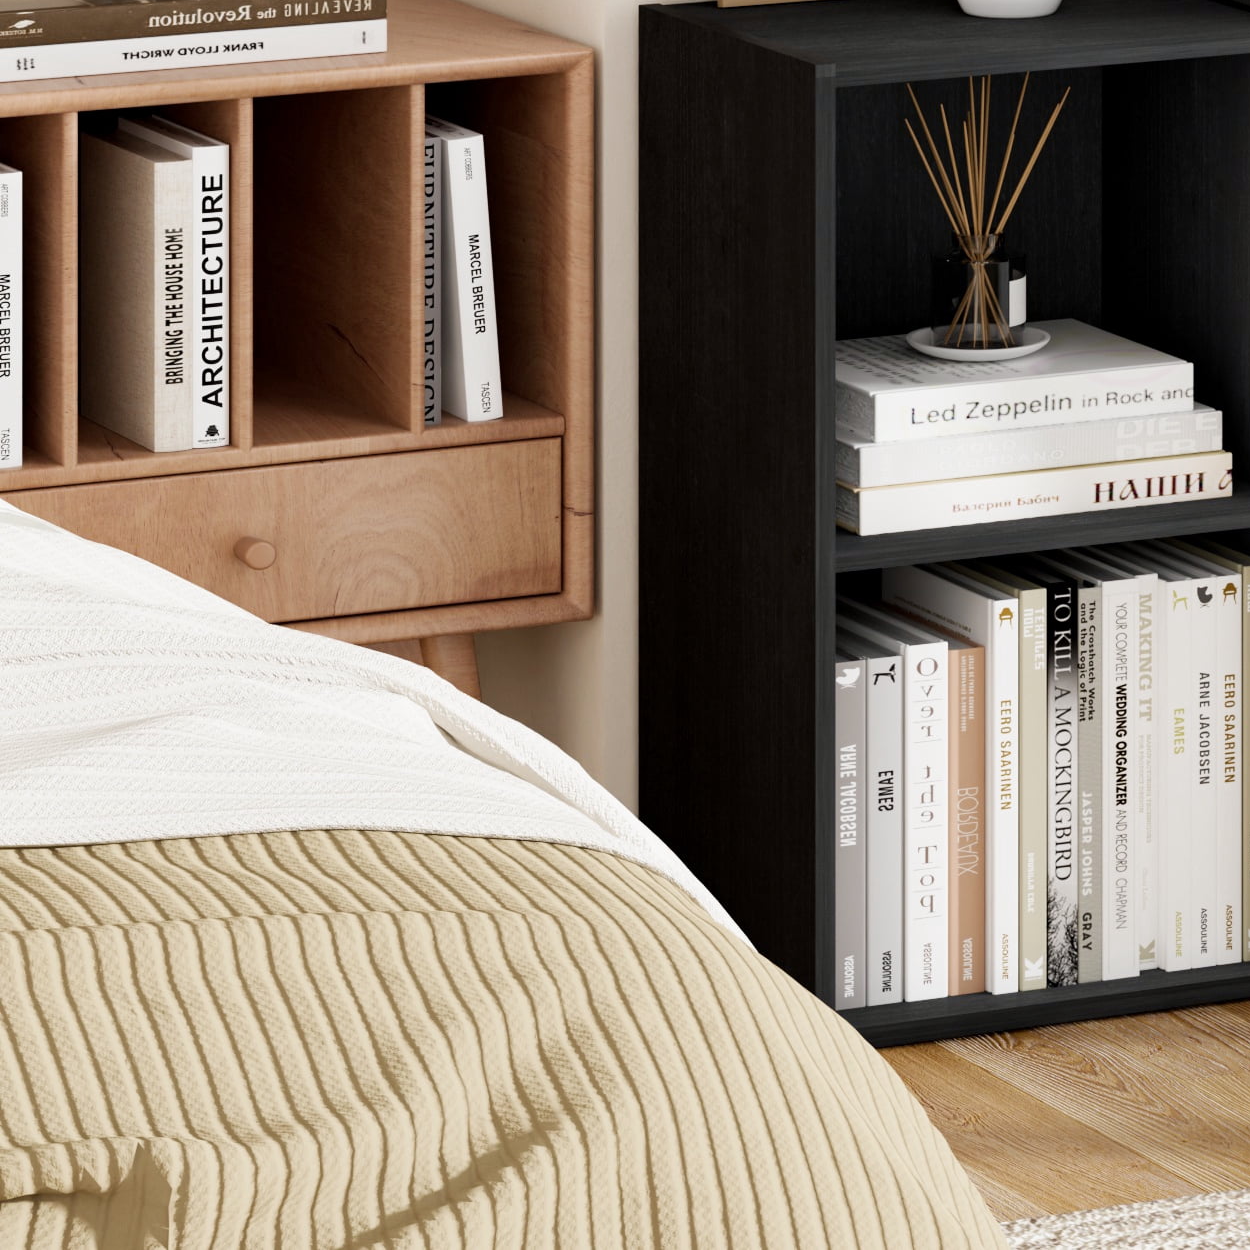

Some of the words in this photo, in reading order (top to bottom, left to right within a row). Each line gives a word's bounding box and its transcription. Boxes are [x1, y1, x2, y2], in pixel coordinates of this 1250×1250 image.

[165, 227, 183, 260] HOME
[468, 234, 483, 283] MARCEL
[0, 274, 11, 325] MARCEL
[165, 263, 183, 301] HOUSE
[201, 174, 223, 407] ARCHITECTURE
[165, 304, 183, 327] THE
[473, 286, 486, 335] BREUER
[0, 328, 11, 378] BREUER
[165, 329, 183, 385] BRINGING
[911, 403, 956, 426] Led
[966, 393, 1072, 422] Zeppelin
[1082, 394, 1099, 409] in
[1106, 390, 1153, 406] Rock
[1093, 471, 1205, 503] НАШИ
[1054, 587, 1072, 623] TO
[1115, 603, 1127, 630] YOUR
[1054, 629, 1072, 681] KILL
[1078, 651, 1087, 678] Logic
[1115, 633, 1127, 682] COMPLETE
[1138, 593, 1153, 690] MAKING
[1054, 686, 1072, 703] A
[1080, 682, 1087, 693] of
[1138, 697, 1153, 721] IT
[1200, 672, 1210, 707] ARNE
[1224, 674, 1236, 709] EERO
[1000, 700, 1012, 735] EERO
[1115, 685, 1127, 738] WEDDING
[1174, 708, 1185, 755] EAMES
[1200, 713, 1210, 785] JACOBSEN
[1224, 714, 1236, 783] SAARINEN
[1000, 741, 1012, 811] SAARINEN
[1054, 707, 1073, 882] MOCKINGBIRD
[1115, 742, 1127, 806] ORGANIZER
[1082, 791, 1092, 844] JASPER
[1115, 810, 1127, 831] AND
[1082, 848, 1092, 896] JOHNS
[1115, 834, 1127, 872] RECORD
[1115, 879, 1127, 929] CHAPMAN
[1225, 904, 1233, 950] ASSOULINE
[1082, 912, 1093, 951] GRAY
[1175, 911, 1183, 957] ASSOULINE
[1200, 908, 1208, 954] ASSOULINE
